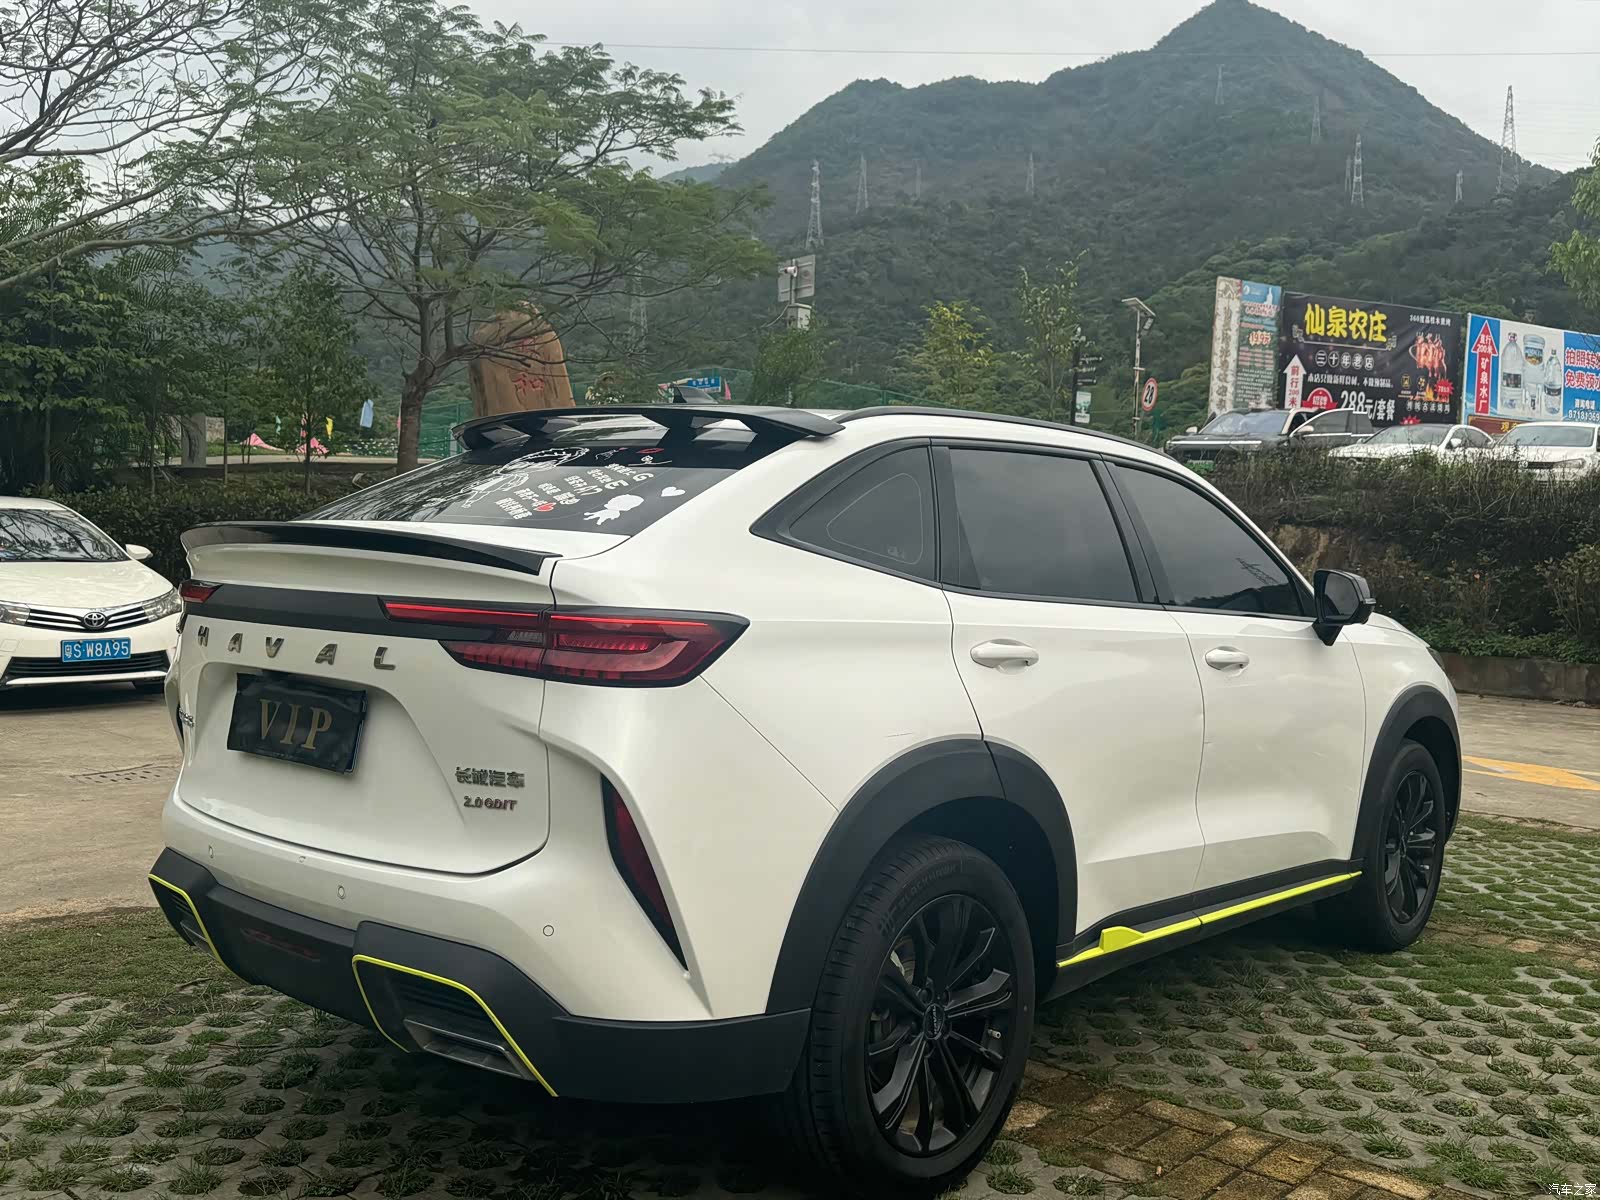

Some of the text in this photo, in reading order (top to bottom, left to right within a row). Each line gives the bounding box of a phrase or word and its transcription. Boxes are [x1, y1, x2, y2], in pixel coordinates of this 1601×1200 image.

[1304, 303, 1387, 343] 仙泉农庄
[1316, 350, 1374, 371] 三十年老店
[1479, 357, 1490, 412] 矿泉水厂
[197, 626, 396, 671] HAVAL
[259, 698, 333, 750] VIP
[455, 766, 525, 788] 长城汽车
